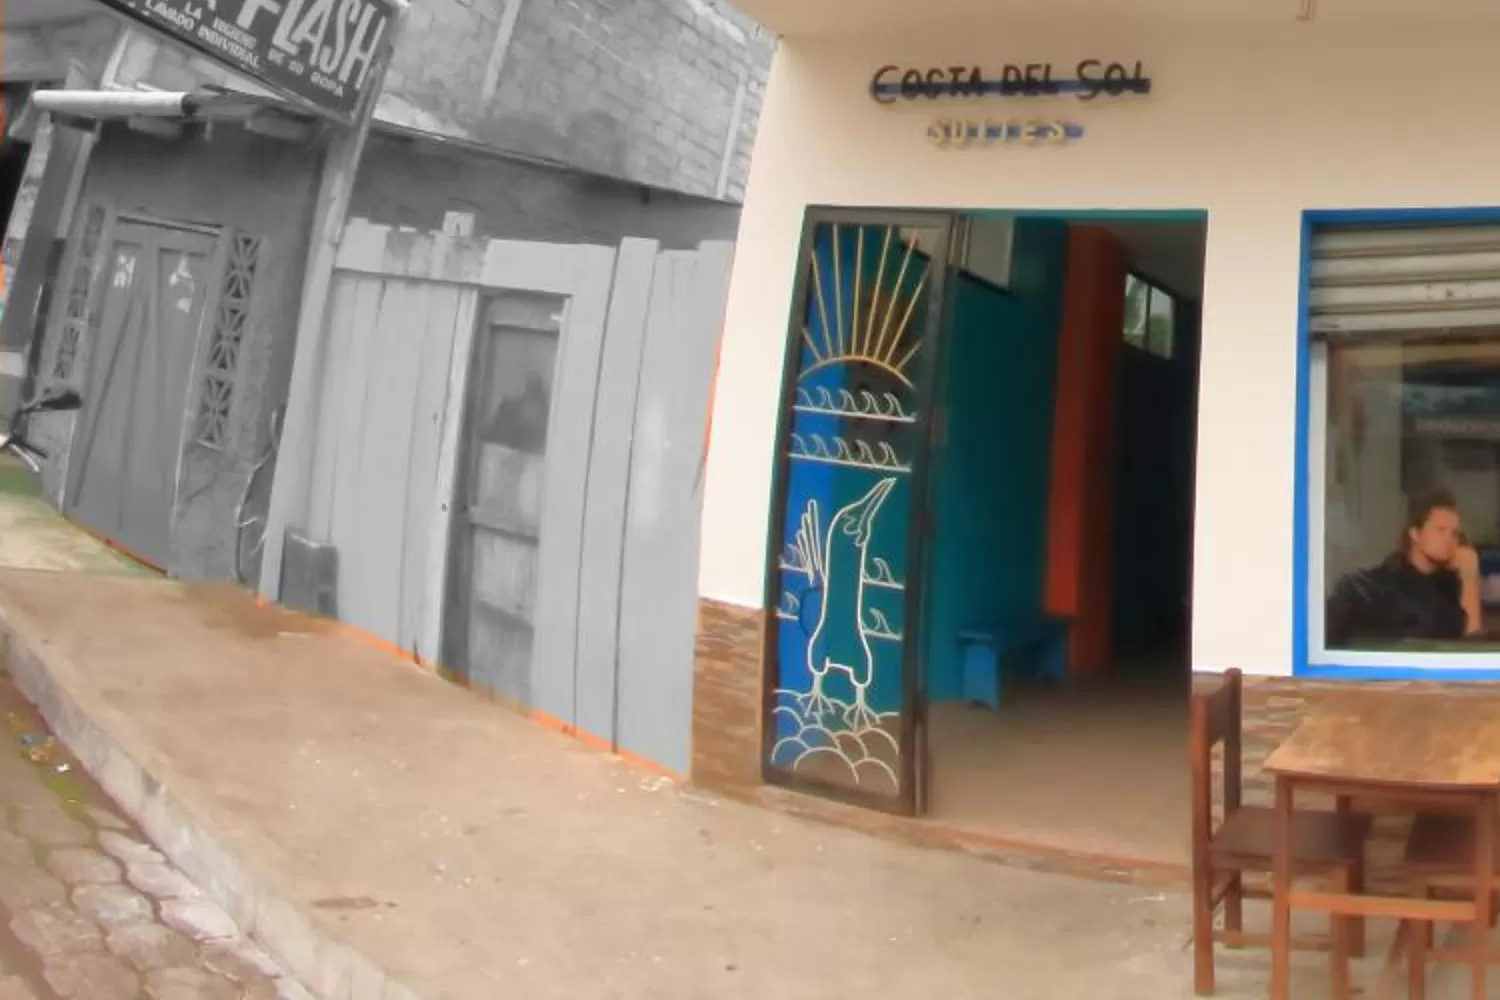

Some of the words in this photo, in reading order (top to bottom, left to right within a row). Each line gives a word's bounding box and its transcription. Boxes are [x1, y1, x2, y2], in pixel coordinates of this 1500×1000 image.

[184, 1, 203, 20] LA
[871, 65, 985, 104] COSTA
[1000, 63, 1059, 97] DEL
[1076, 59, 1150, 101] SOL
